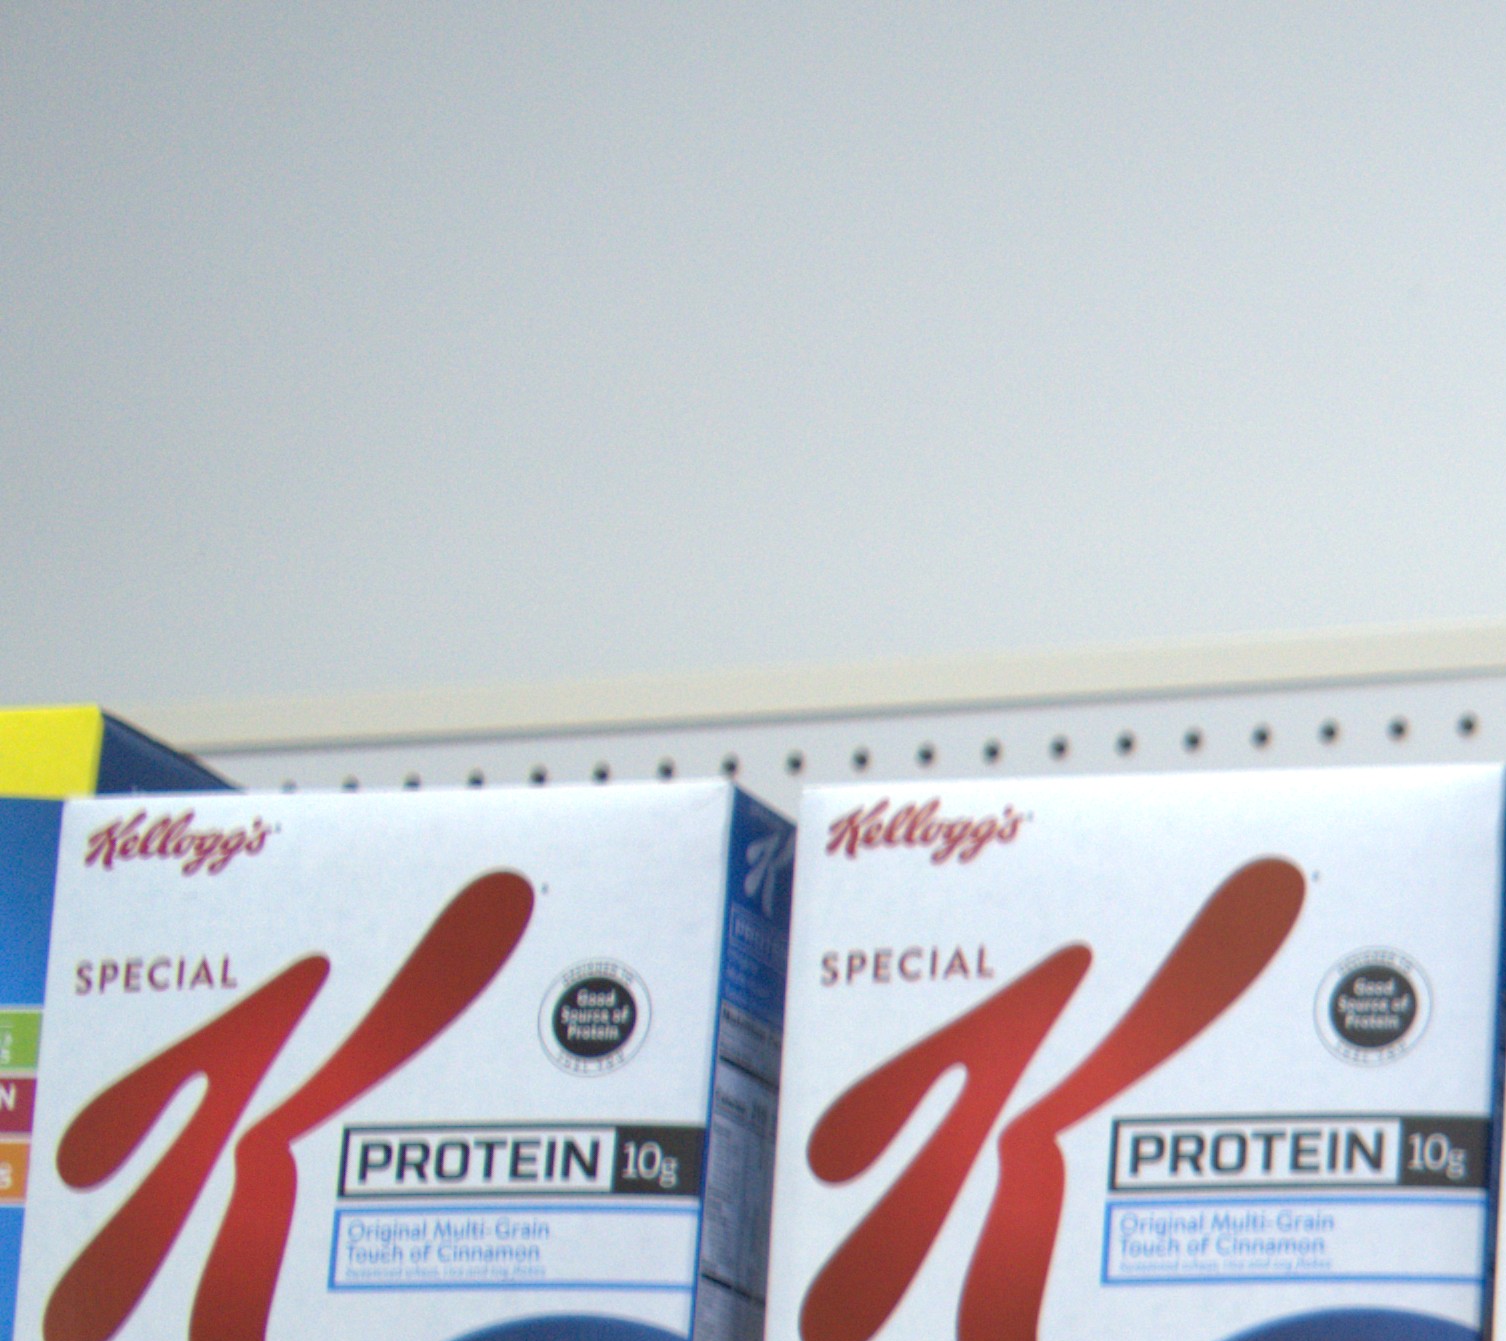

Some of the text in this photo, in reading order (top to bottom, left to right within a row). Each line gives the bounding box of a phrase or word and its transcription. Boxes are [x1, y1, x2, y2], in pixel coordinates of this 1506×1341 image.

[85, 810, 270, 875] Kellogg's
[826, 799, 1021, 864] Kellogg's
[75, 955, 238, 995] SPECIAL
[820, 945, 994, 986] SPECIAL
[358, 1137, 600, 1185] PROTEIN
[622, 1141, 678, 1188] 10g
[1129, 1131, 1386, 1178] PROTEIN
[1407, 1135, 1467, 1179] 10g
[346, 1242, 541, 1265] Touch of Cinnamon
[347, 1219, 551, 1245] Original Multi-Grain
